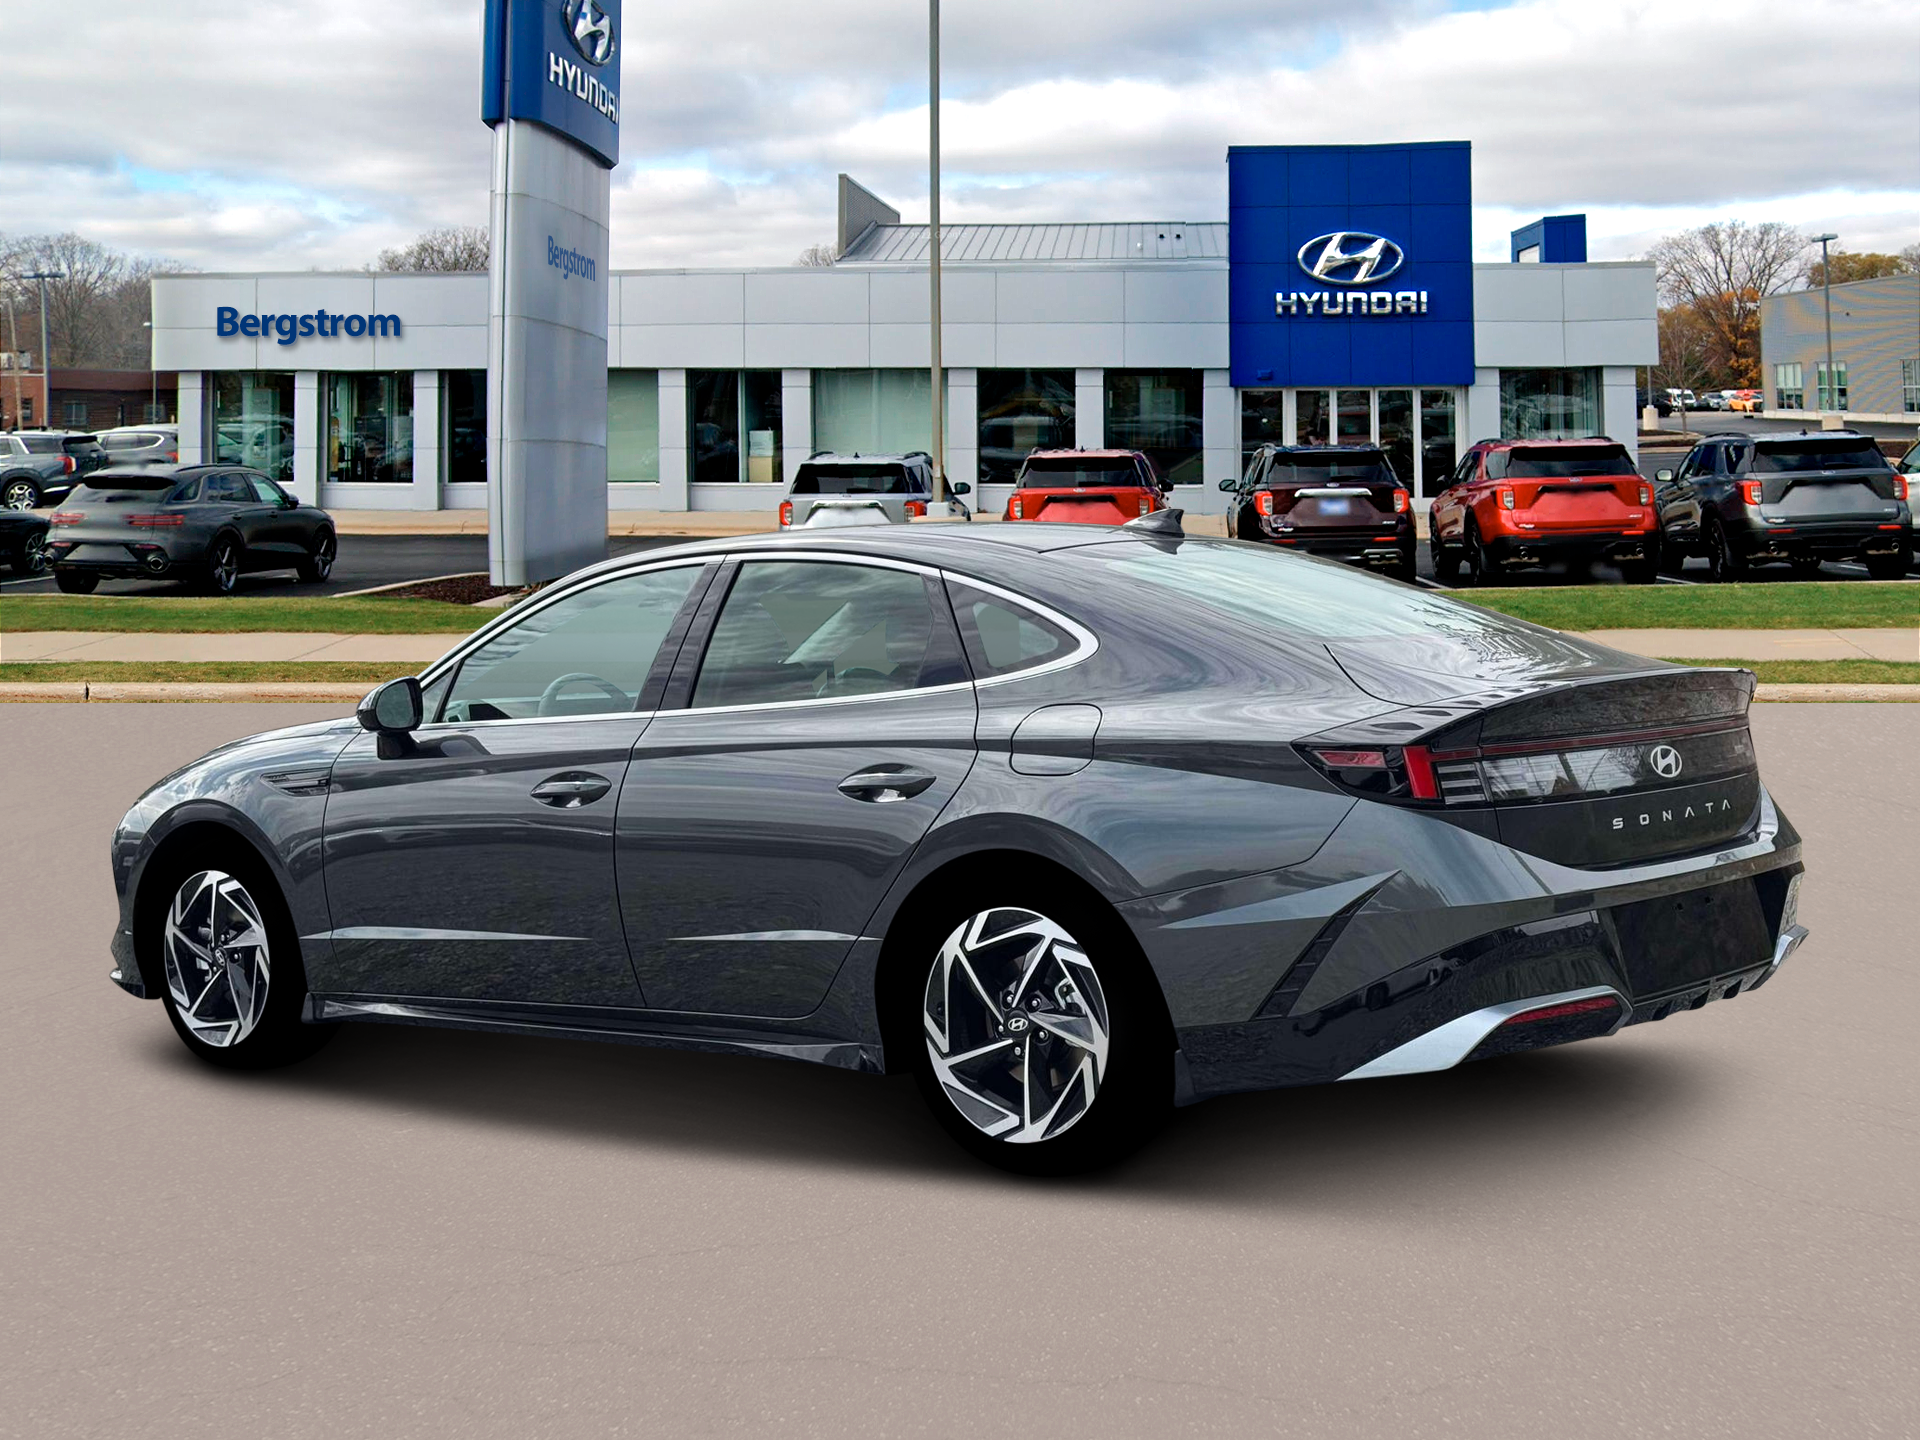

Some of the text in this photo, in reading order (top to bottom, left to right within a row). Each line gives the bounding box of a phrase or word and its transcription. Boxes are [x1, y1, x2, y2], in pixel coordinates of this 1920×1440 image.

[549, 52, 619, 124] HYUNDAI
[547, 235, 596, 281] Bergstrom
[1275, 291, 1428, 315] HYUNDAI
[216, 306, 402, 346] Bergstrom
[1612, 799, 1731, 830] SONATA
